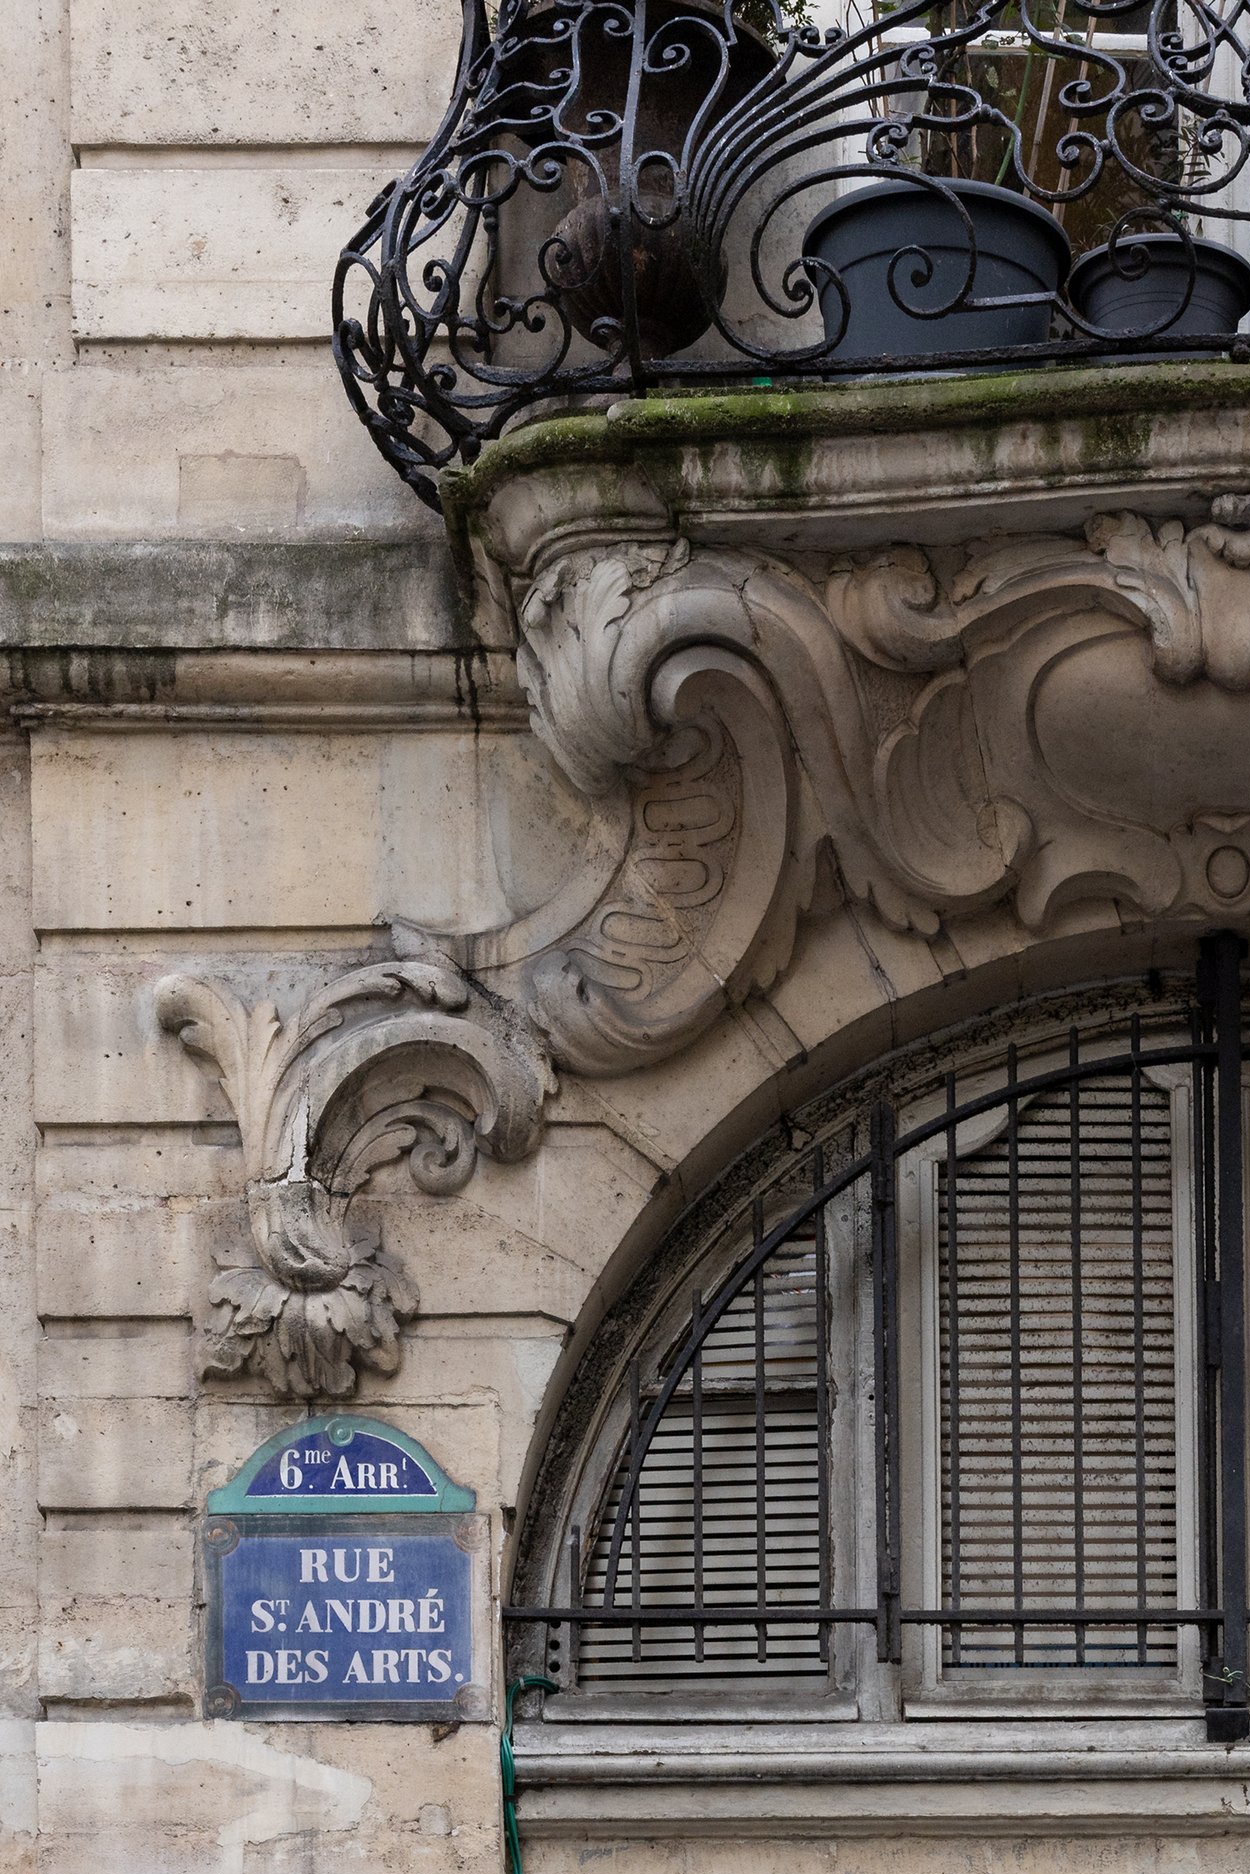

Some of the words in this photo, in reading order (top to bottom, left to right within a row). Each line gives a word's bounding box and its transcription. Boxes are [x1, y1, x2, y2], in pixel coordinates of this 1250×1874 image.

[299, 1548, 395, 1583] RUE
[296, 1588, 445, 1633] ANDRÉ
[245, 1649, 329, 1684] DES
[342, 1649, 464, 1684] ARTS.
